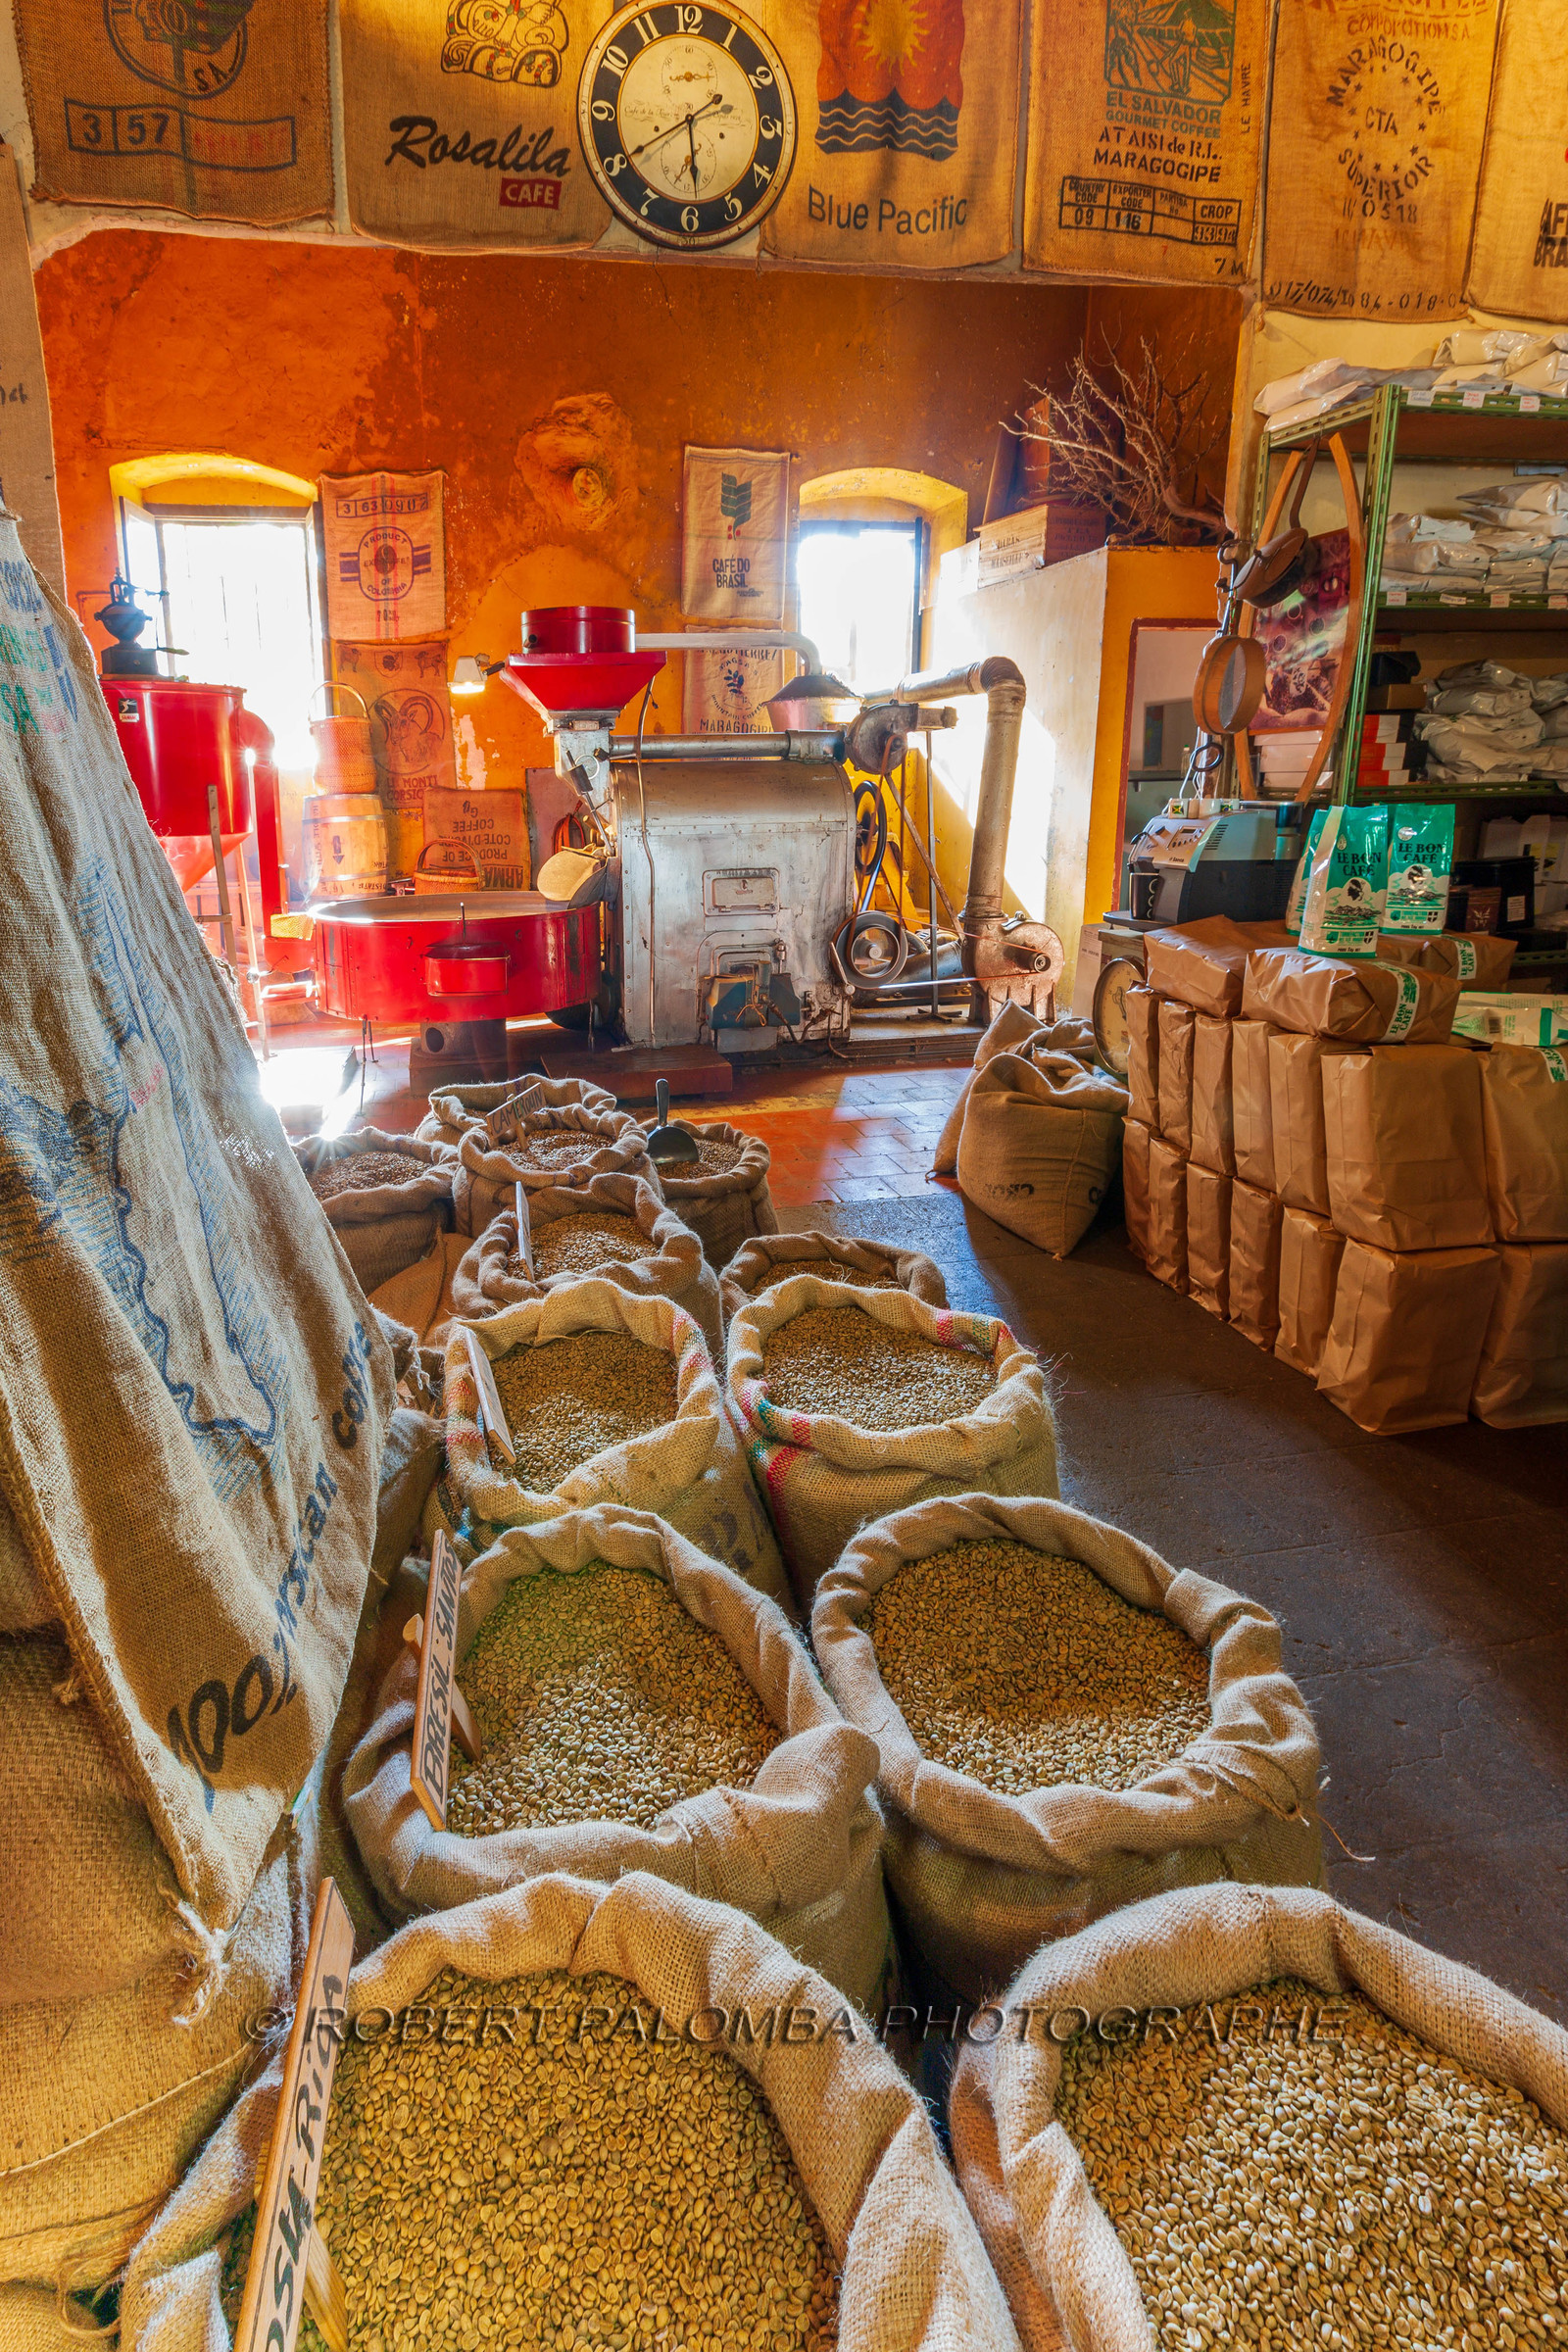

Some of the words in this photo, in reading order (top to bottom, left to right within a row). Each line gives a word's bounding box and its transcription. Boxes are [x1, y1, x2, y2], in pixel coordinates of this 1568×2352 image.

[631, 12, 662, 47] 11
[674, 5, 703, 35] 12
[720, 22, 738, 52] 1
[600, 45, 629, 80] 10
[747, 66, 774, 90] 2
[1241, 63, 1251, 107] HAVRE
[591, 99, 616, 122] 9
[1106, 91, 1128, 108] EL
[1131, 94, 1222, 124] SALVADOR
[82, 114, 102, 144] 3
[127, 113, 170, 145] 57
[760, 115, 782, 140] 3
[1105, 110, 1168, 128] GOURMET
[1171, 119, 1221, 139] COFFEE
[1241, 116, 1251, 134] LE
[1366, 106, 1397, 135] CTA
[384, 115, 571, 177] Rosalila
[1167, 136, 1186, 155] de
[603, 153, 627, 177] 8
[753, 162, 774, 189] 4
[1094, 148, 1223, 183] MARAGOGIPE
[1339, 148, 1435, 201] SUPERIOR
[506, 183, 555, 205] CAFE
[640, 187, 660, 216] 7
[1068, 178, 1105, 193] COUNTRY
[1112, 184, 1152, 198] EXPORTER
[1200, 204, 1233, 219] CROP
[1075, 192, 1098, 204] CODE
[1120, 196, 1144, 209] CODE
[724, 192, 743, 221] 5
[808, 183, 868, 230] Blue
[878, 195, 967, 235] Pacific
[1074, 208, 1095, 225] 09
[680, 206, 700, 232] 6
[343, 504, 351, 514] 3
[362, 501, 378, 512] 63
[364, 533, 408, 549] PRODUCT
[712, 555, 736, 573] CAFÉ
[737, 558, 751, 573] DO
[367, 582, 408, 596] COLOMBIA
[716, 573, 748, 588] BRASIL
[402, 775, 438, 789] MONTI
[387, 789, 424, 801] CORSIC
[453, 819, 494, 833] COFFEE
[485, 834, 511, 846] COTE
[1398, 843, 1412, 853] LE
[1415, 843, 1446, 853] BON
[442, 853, 455, 861] OF
[462, 849, 507, 860] PRODCE
[1338, 853, 1349, 864] LE
[1350, 853, 1382, 864] BON
[1459, 949, 1468, 966] BON
[1390, 1020, 1399, 1035] LE
[1395, 1004, 1407, 1022] BON
[492, 1087, 543, 1135] CAMEROUN
